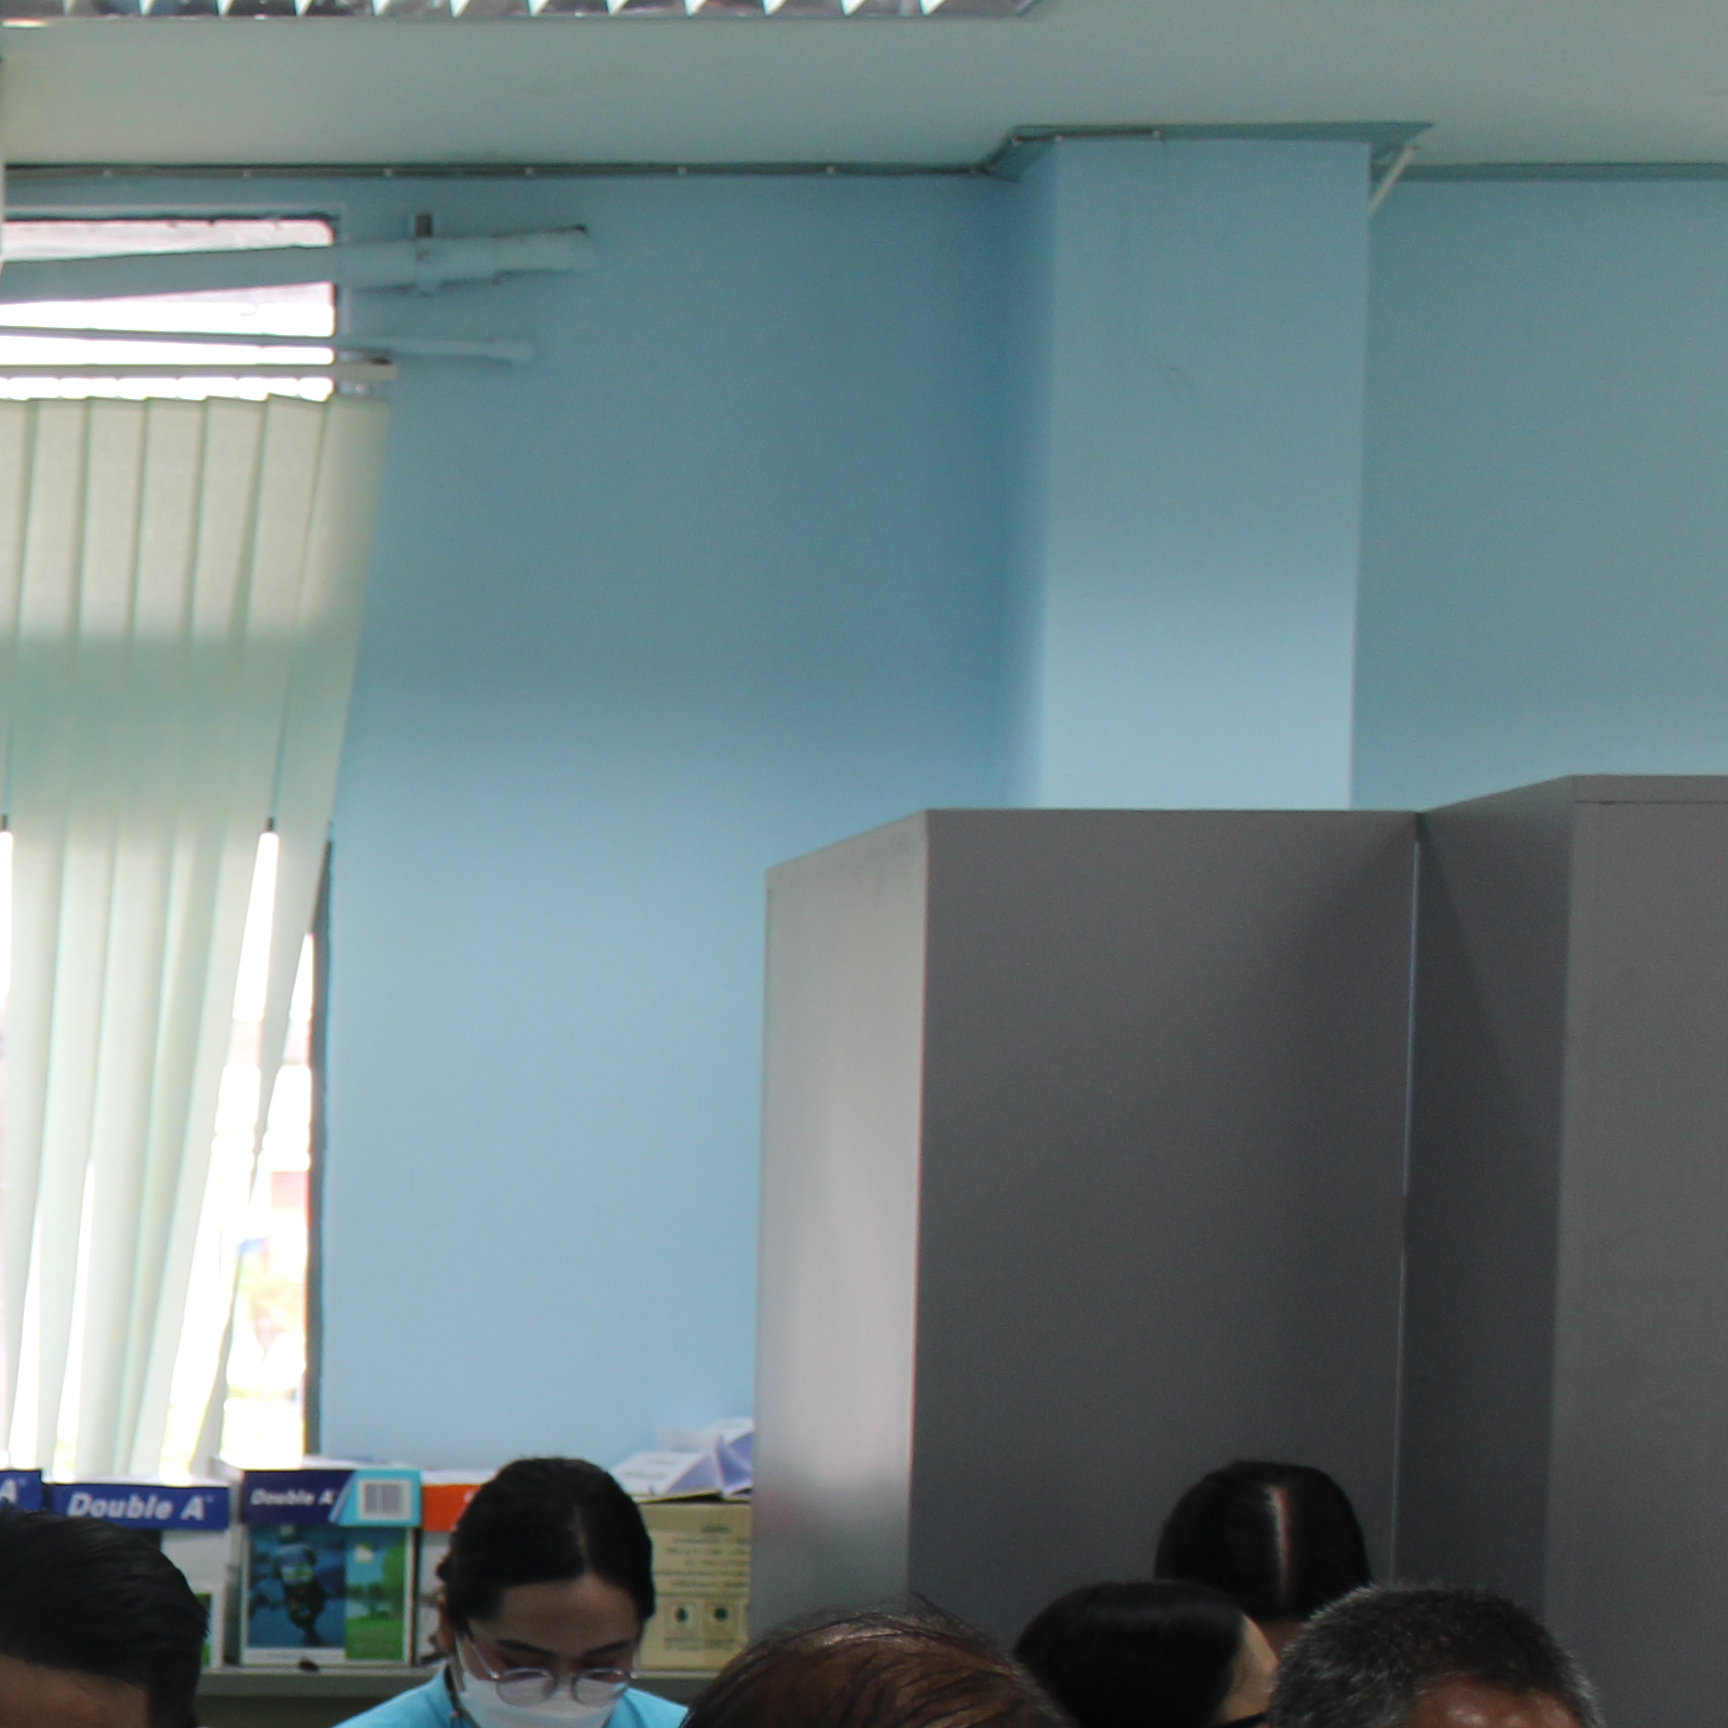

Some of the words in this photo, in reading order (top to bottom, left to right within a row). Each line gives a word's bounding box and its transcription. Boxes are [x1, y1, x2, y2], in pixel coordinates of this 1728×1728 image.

[66, 1492, 173, 1520] Double
[180, 1495, 206, 1521] A
[249, 1488, 315, 1507] Double
[317, 1489, 335, 1506] A
